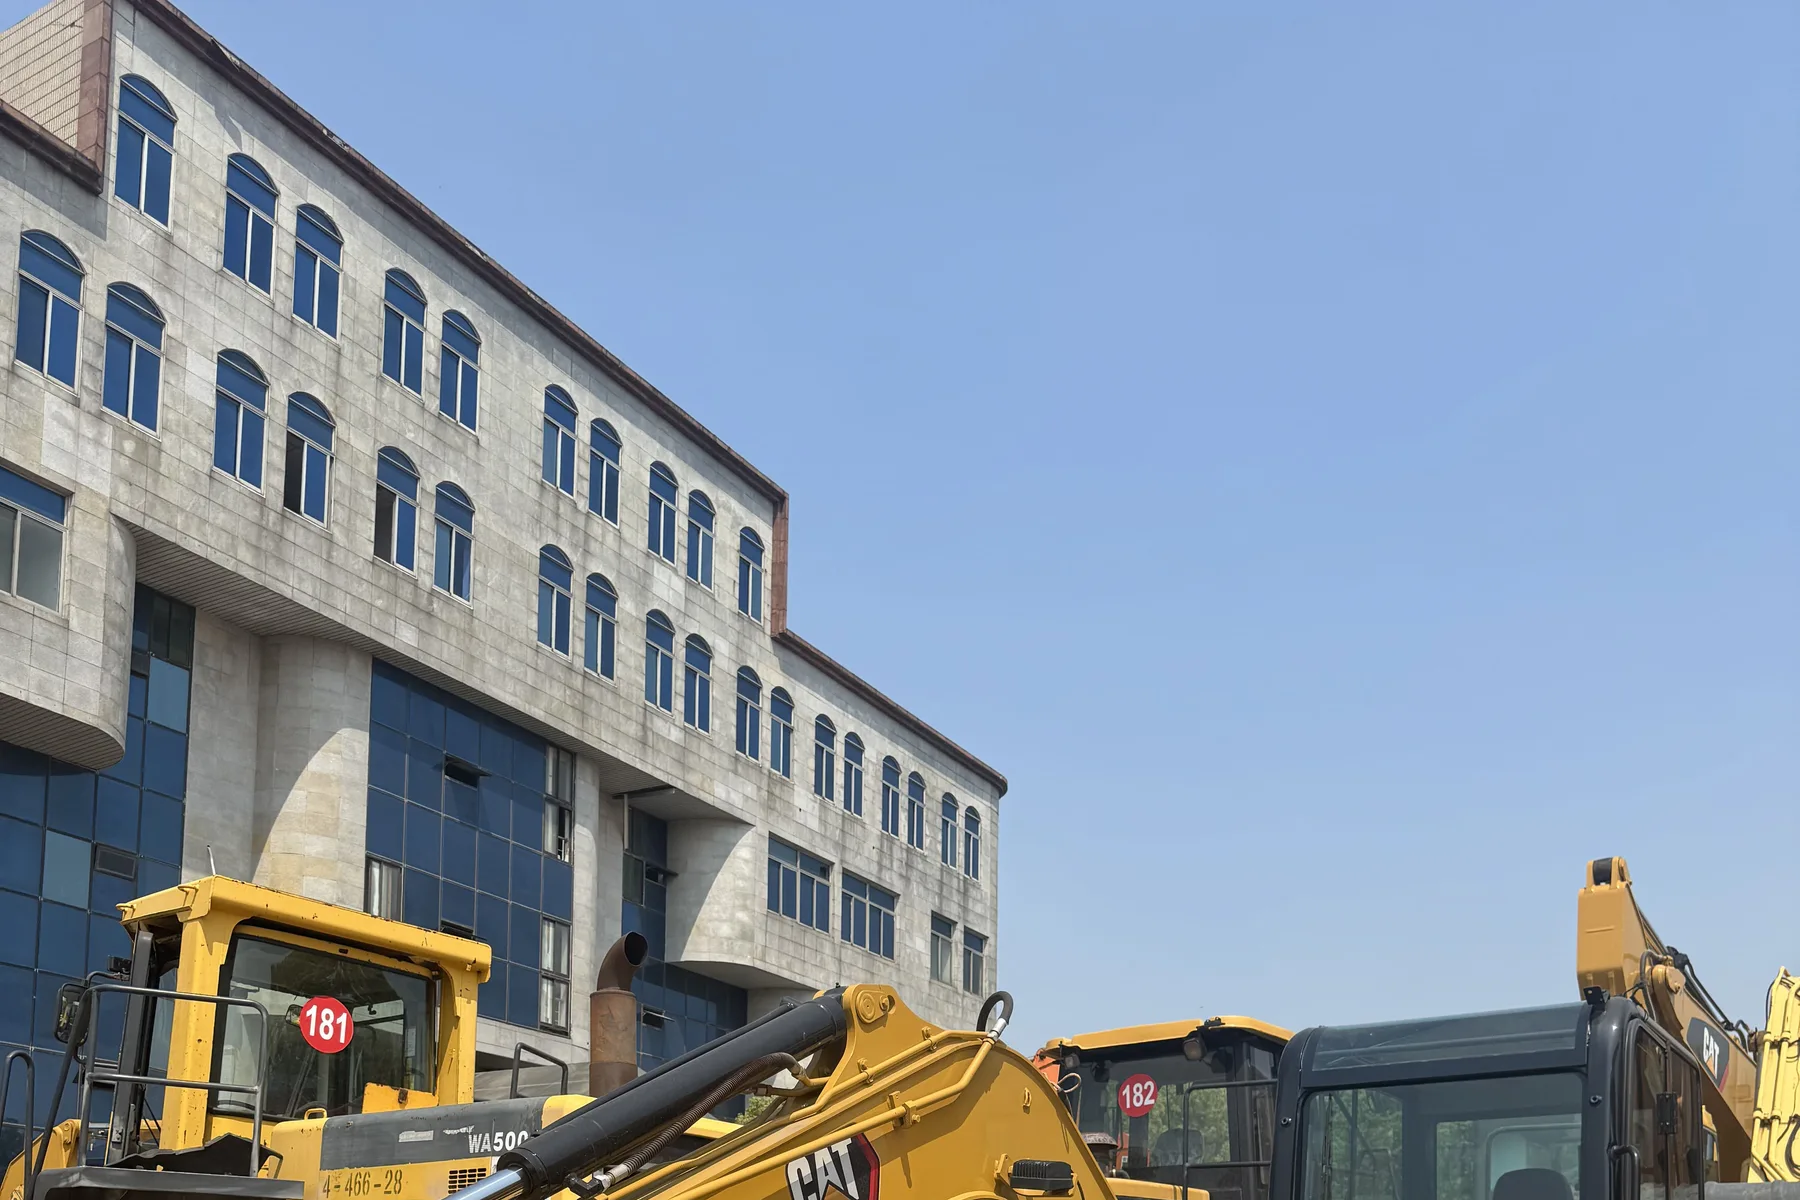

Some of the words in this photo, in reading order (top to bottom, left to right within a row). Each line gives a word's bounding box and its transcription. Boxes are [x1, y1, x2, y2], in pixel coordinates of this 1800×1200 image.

[306, 1004, 347, 1044] 181
[1702, 1026, 1720, 1080] CAT
[1122, 1080, 1155, 1109] 182
